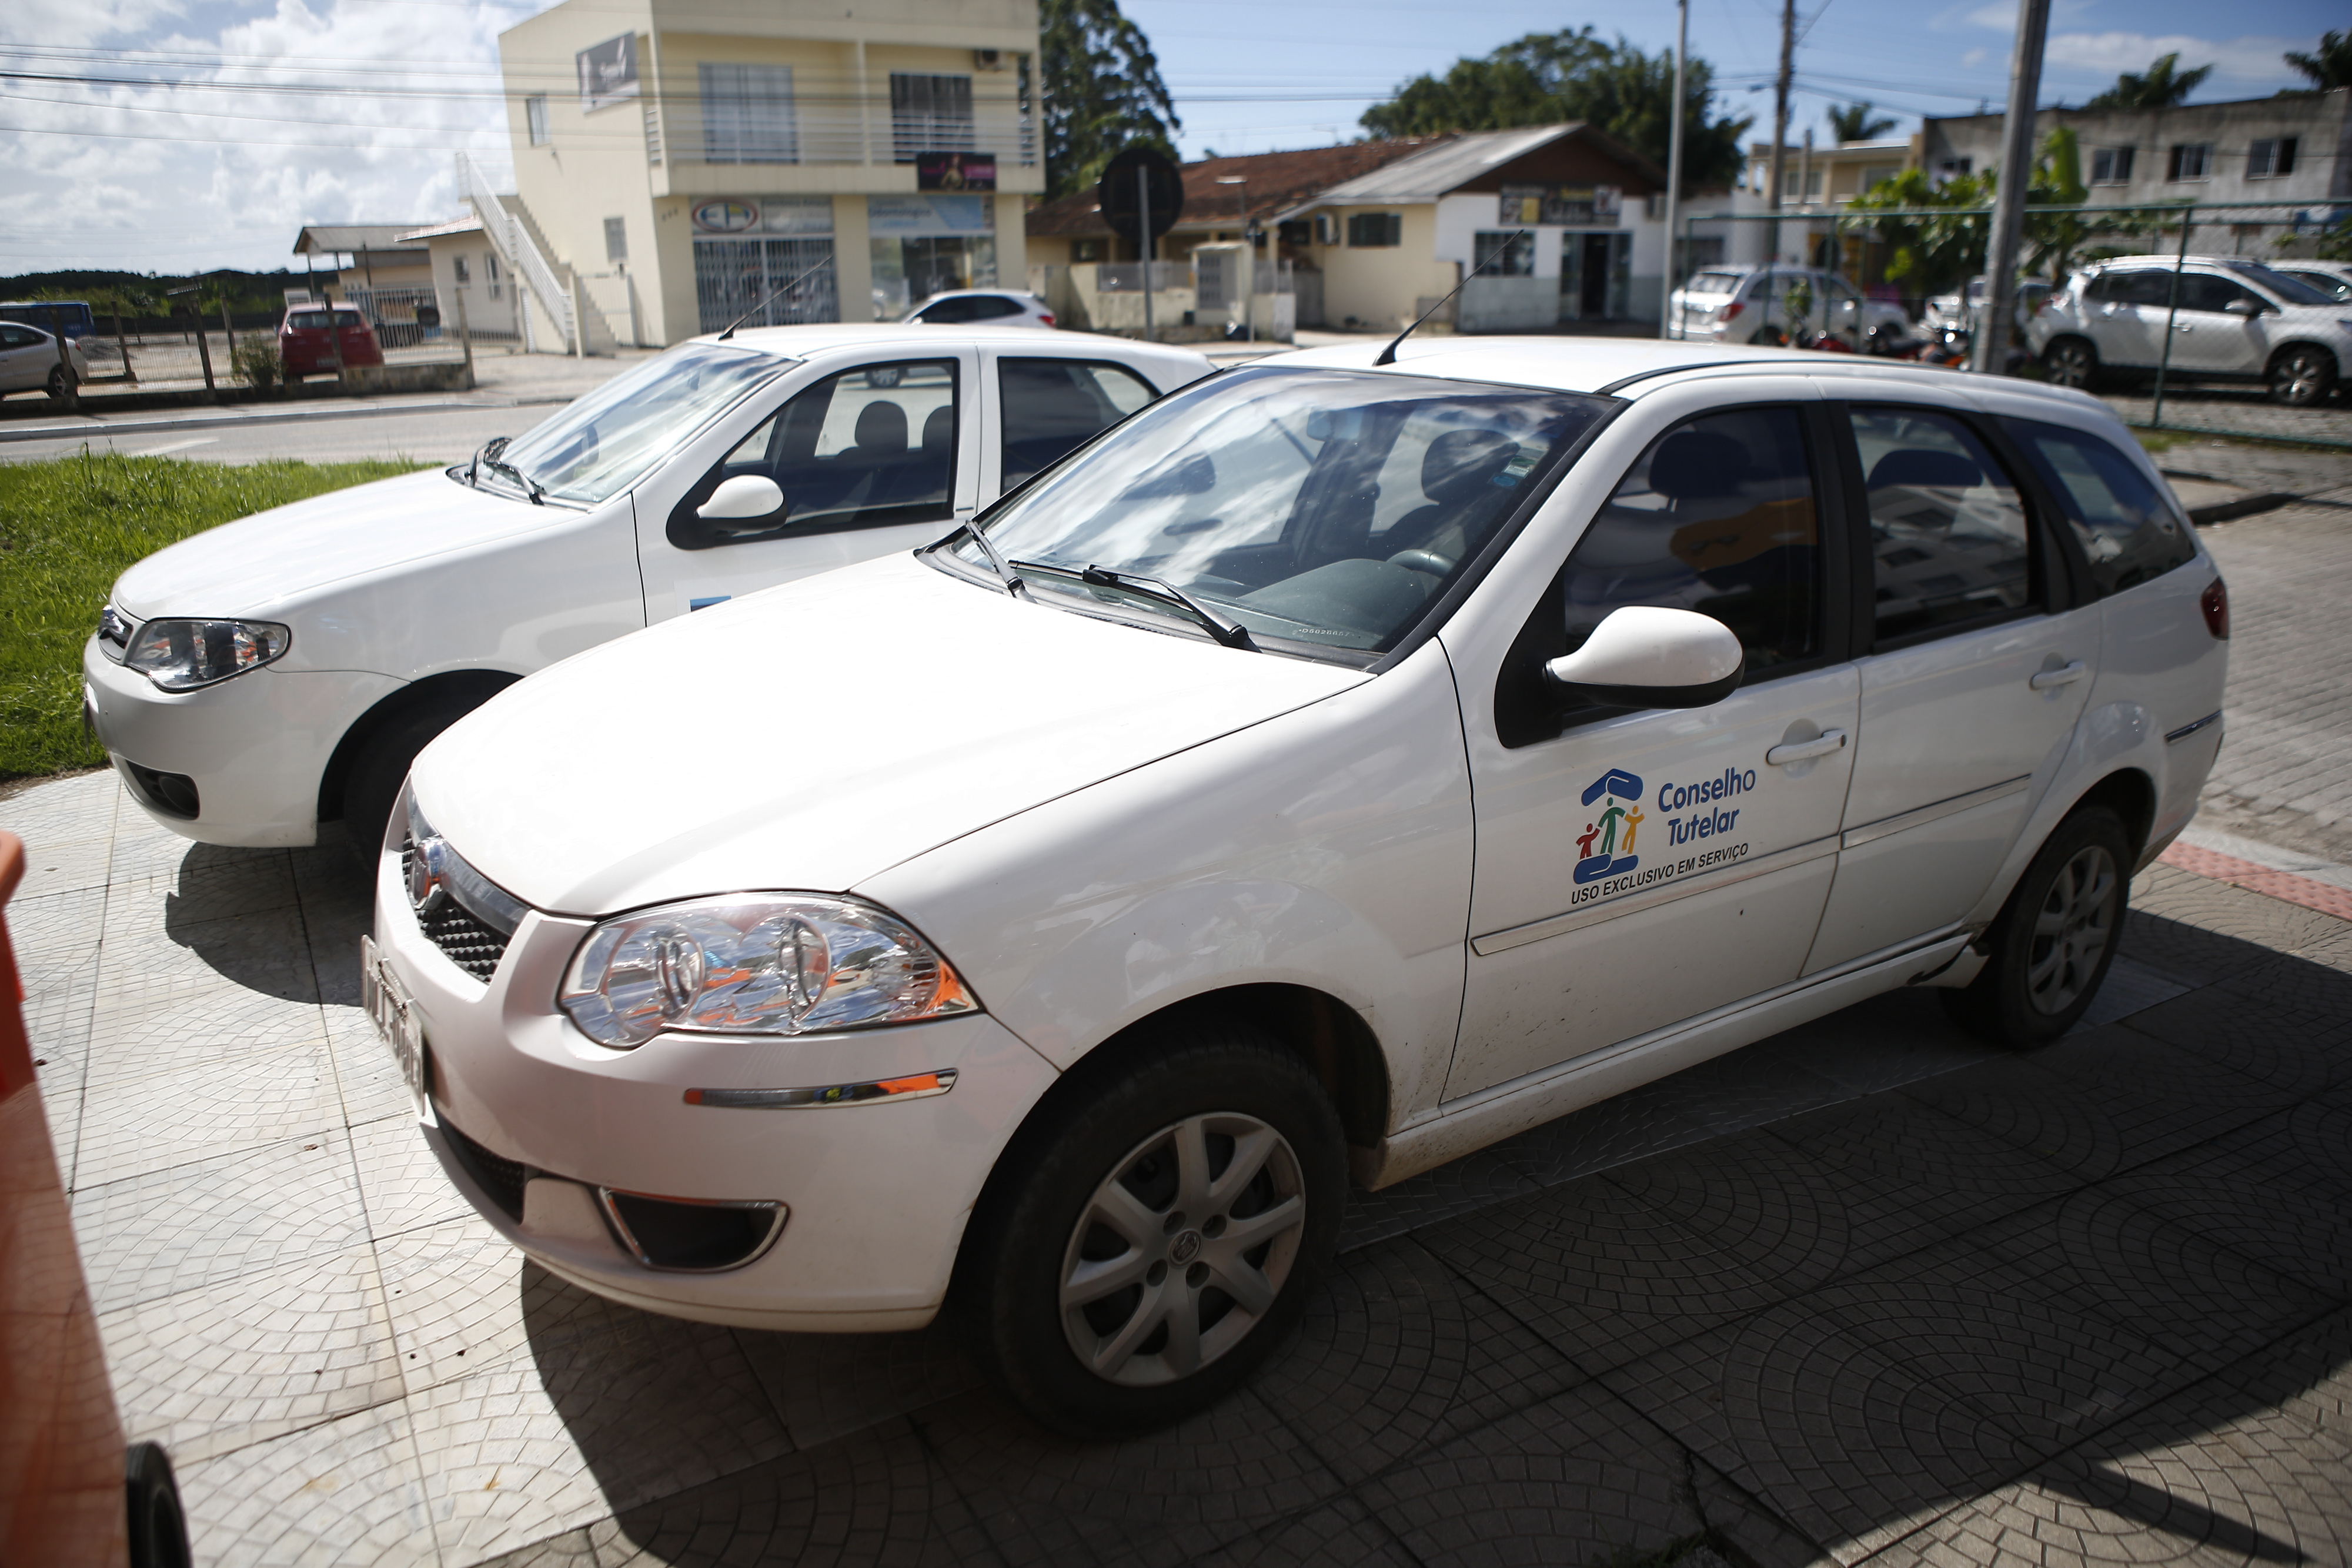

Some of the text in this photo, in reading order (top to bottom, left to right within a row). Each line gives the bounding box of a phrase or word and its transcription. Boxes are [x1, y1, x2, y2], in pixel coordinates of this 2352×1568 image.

[1658, 767, 1756, 813] Conselho
[1668, 806, 1740, 847] Tutelar
[1571, 842, 1749, 904] USO EXCLUSIVO EM SERVIÇO
